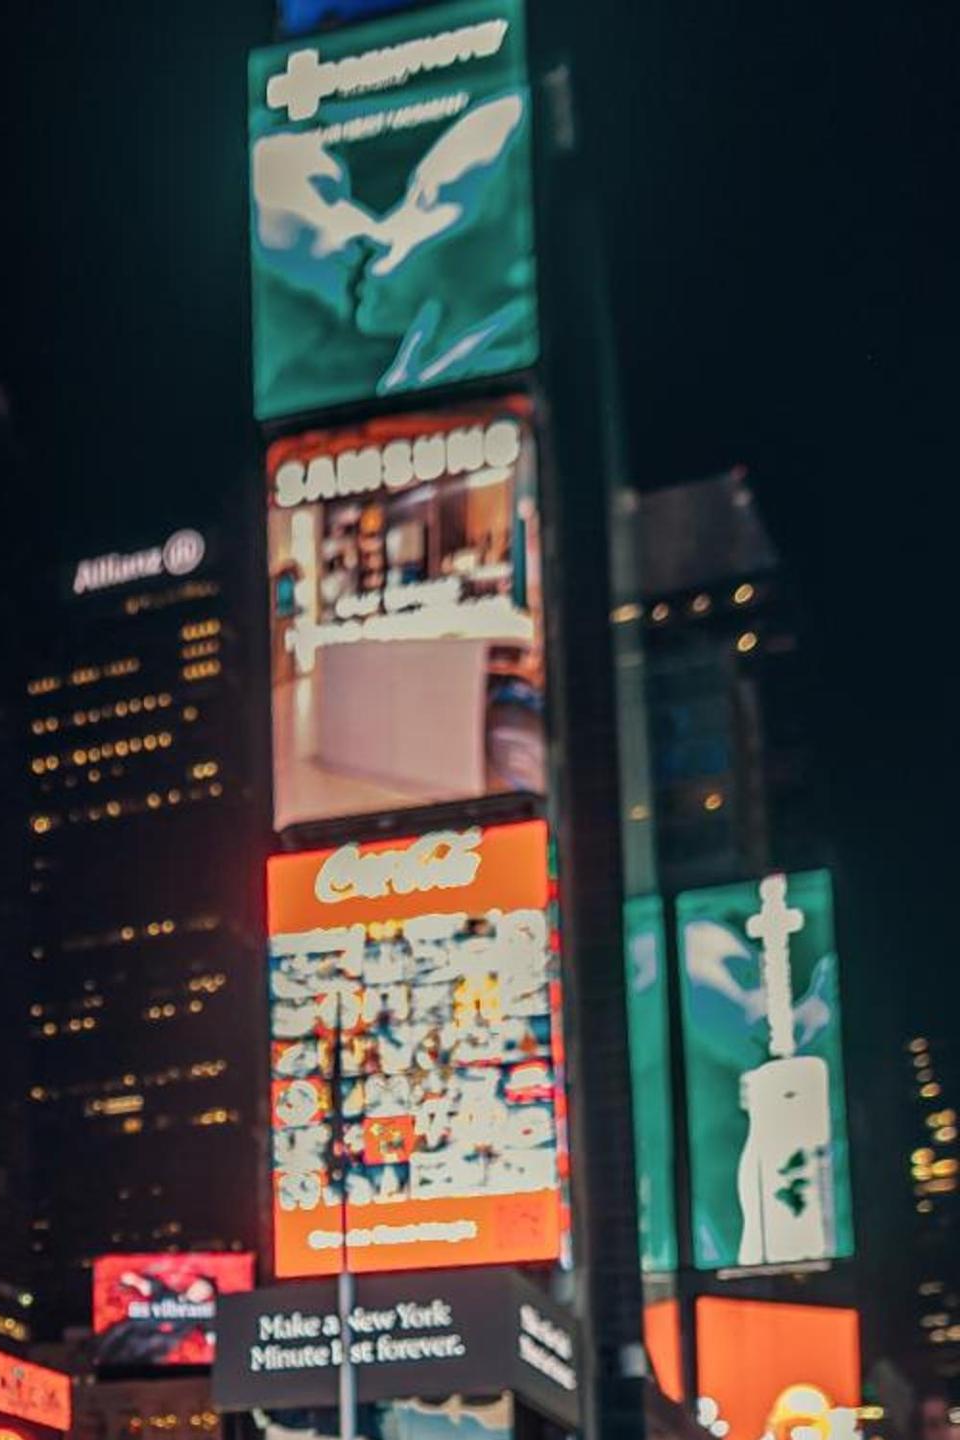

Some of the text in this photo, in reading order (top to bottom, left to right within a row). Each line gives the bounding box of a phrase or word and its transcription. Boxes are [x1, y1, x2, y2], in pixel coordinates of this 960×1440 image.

[259, 1311, 321, 1341] Make
[322, 1315, 340, 1336] a
[396, 1299, 452, 1329] York
[250, 1334, 465, 1372] Minute lst forever.
